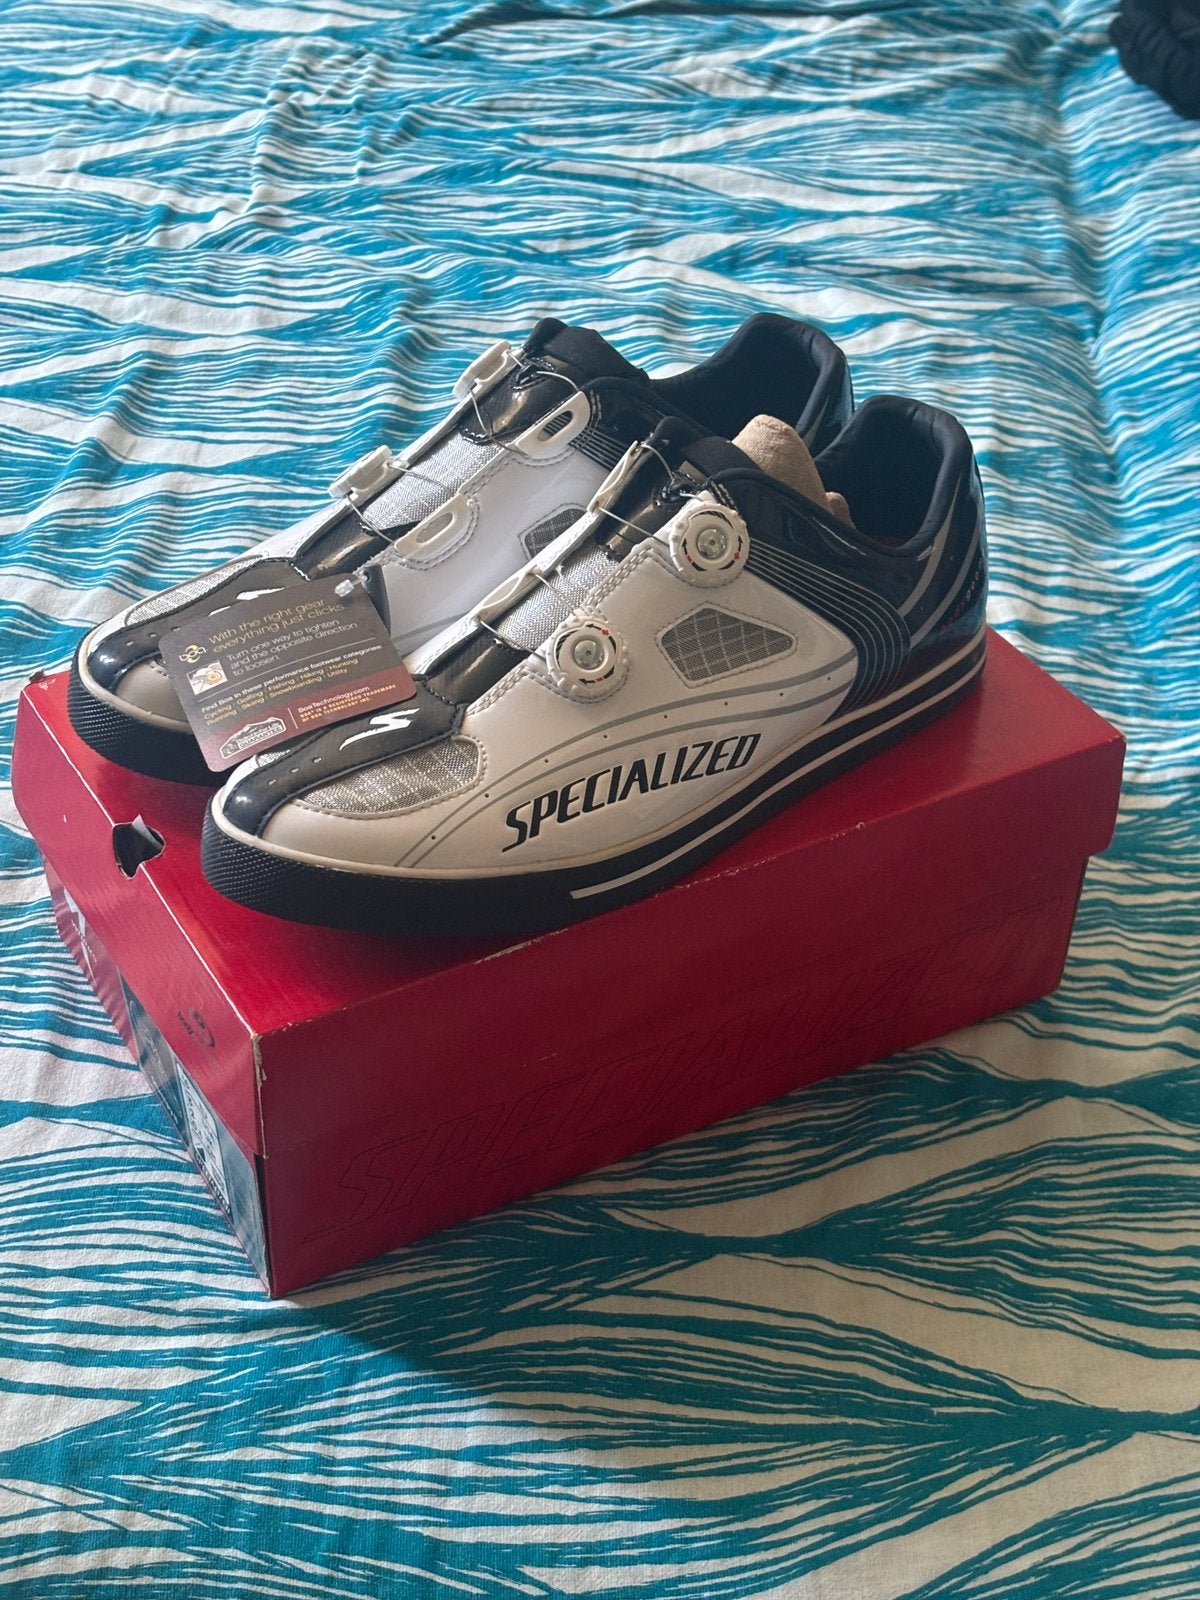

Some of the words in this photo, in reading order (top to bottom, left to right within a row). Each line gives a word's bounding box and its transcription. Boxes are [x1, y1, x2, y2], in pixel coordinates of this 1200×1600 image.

[209, 628, 237, 644] With
[239, 620, 261, 632] the
[263, 608, 293, 623] right
[295, 600, 324, 615] gear
[213, 623, 279, 653] everything
[281, 614, 305, 628] just
[227, 650, 249, 661] Turn
[251, 642, 270, 652] one
[272, 634, 291, 644] way
[305, 619, 340, 633] tighten
[231, 657, 250, 669] and
[252, 650, 269, 660] the
[270, 635, 313, 653] opposite
[315, 623, 358, 639] direction
[201, 703, 218, 713] Find
[218, 696, 233, 706] Boa
[241, 683, 262, 694] these
[263, 666, 309, 687] performance
[310, 656, 342, 669] footwear
[343, 644, 383, 659] categories:
[204, 704, 232, 719] Cycling
[236, 691, 264, 705] Golfing
[268, 679, 295, 691] Fishing
[300, 669, 324, 680] Hiking
[329, 658, 359, 670] Hunting
[206, 709, 237, 726] Running
[241, 698, 265, 710] Skiing
[269, 676, 322, 698] Snowboarding
[327, 669, 348, 678] Utility
[297, 686, 370, 713] BoaTechnology.com
[363, 684, 396, 697] TRADEMARK
[501, 733, 762, 853] SPECIALIZED
[301, 896, 1063, 1245] SPECIALIZED
